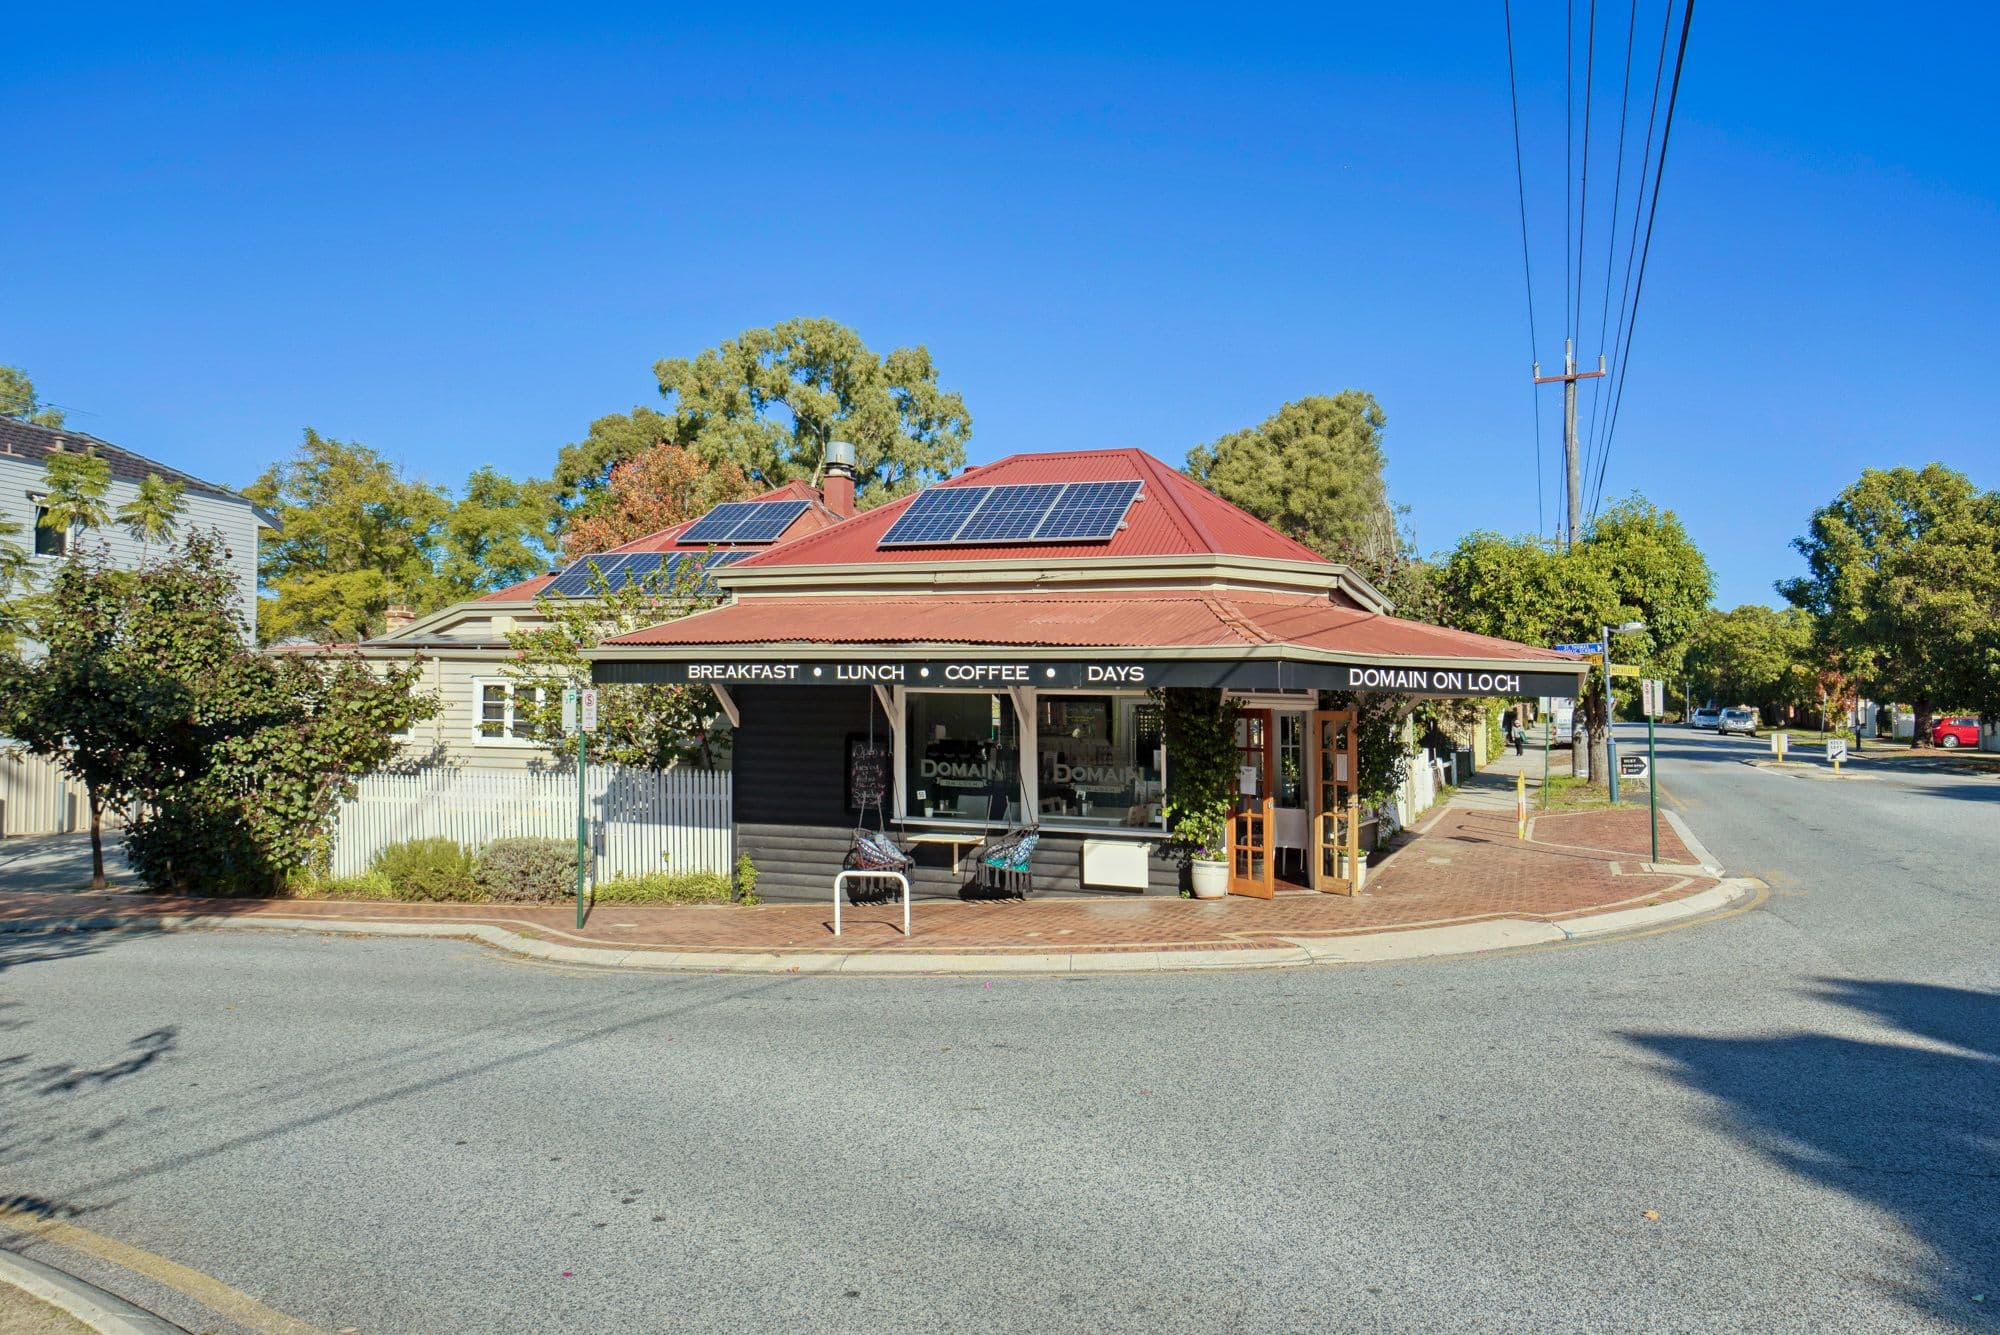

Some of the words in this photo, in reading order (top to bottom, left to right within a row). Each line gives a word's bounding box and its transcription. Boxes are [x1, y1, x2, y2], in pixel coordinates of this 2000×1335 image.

[688, 665, 799, 679] BREAKFAST
[837, 665, 905, 681] LUNCH
[945, 665, 1029, 680] COFFEE
[1088, 666, 1144, 681] DAYS
[1349, 668, 1427, 688] DOMAIN
[1433, 672, 1462, 690] ON
[1468, 673, 1520, 692] LOCH
[920, 759, 1004, 781] DOMAIN
[1053, 763, 1145, 784] DOMAIN
